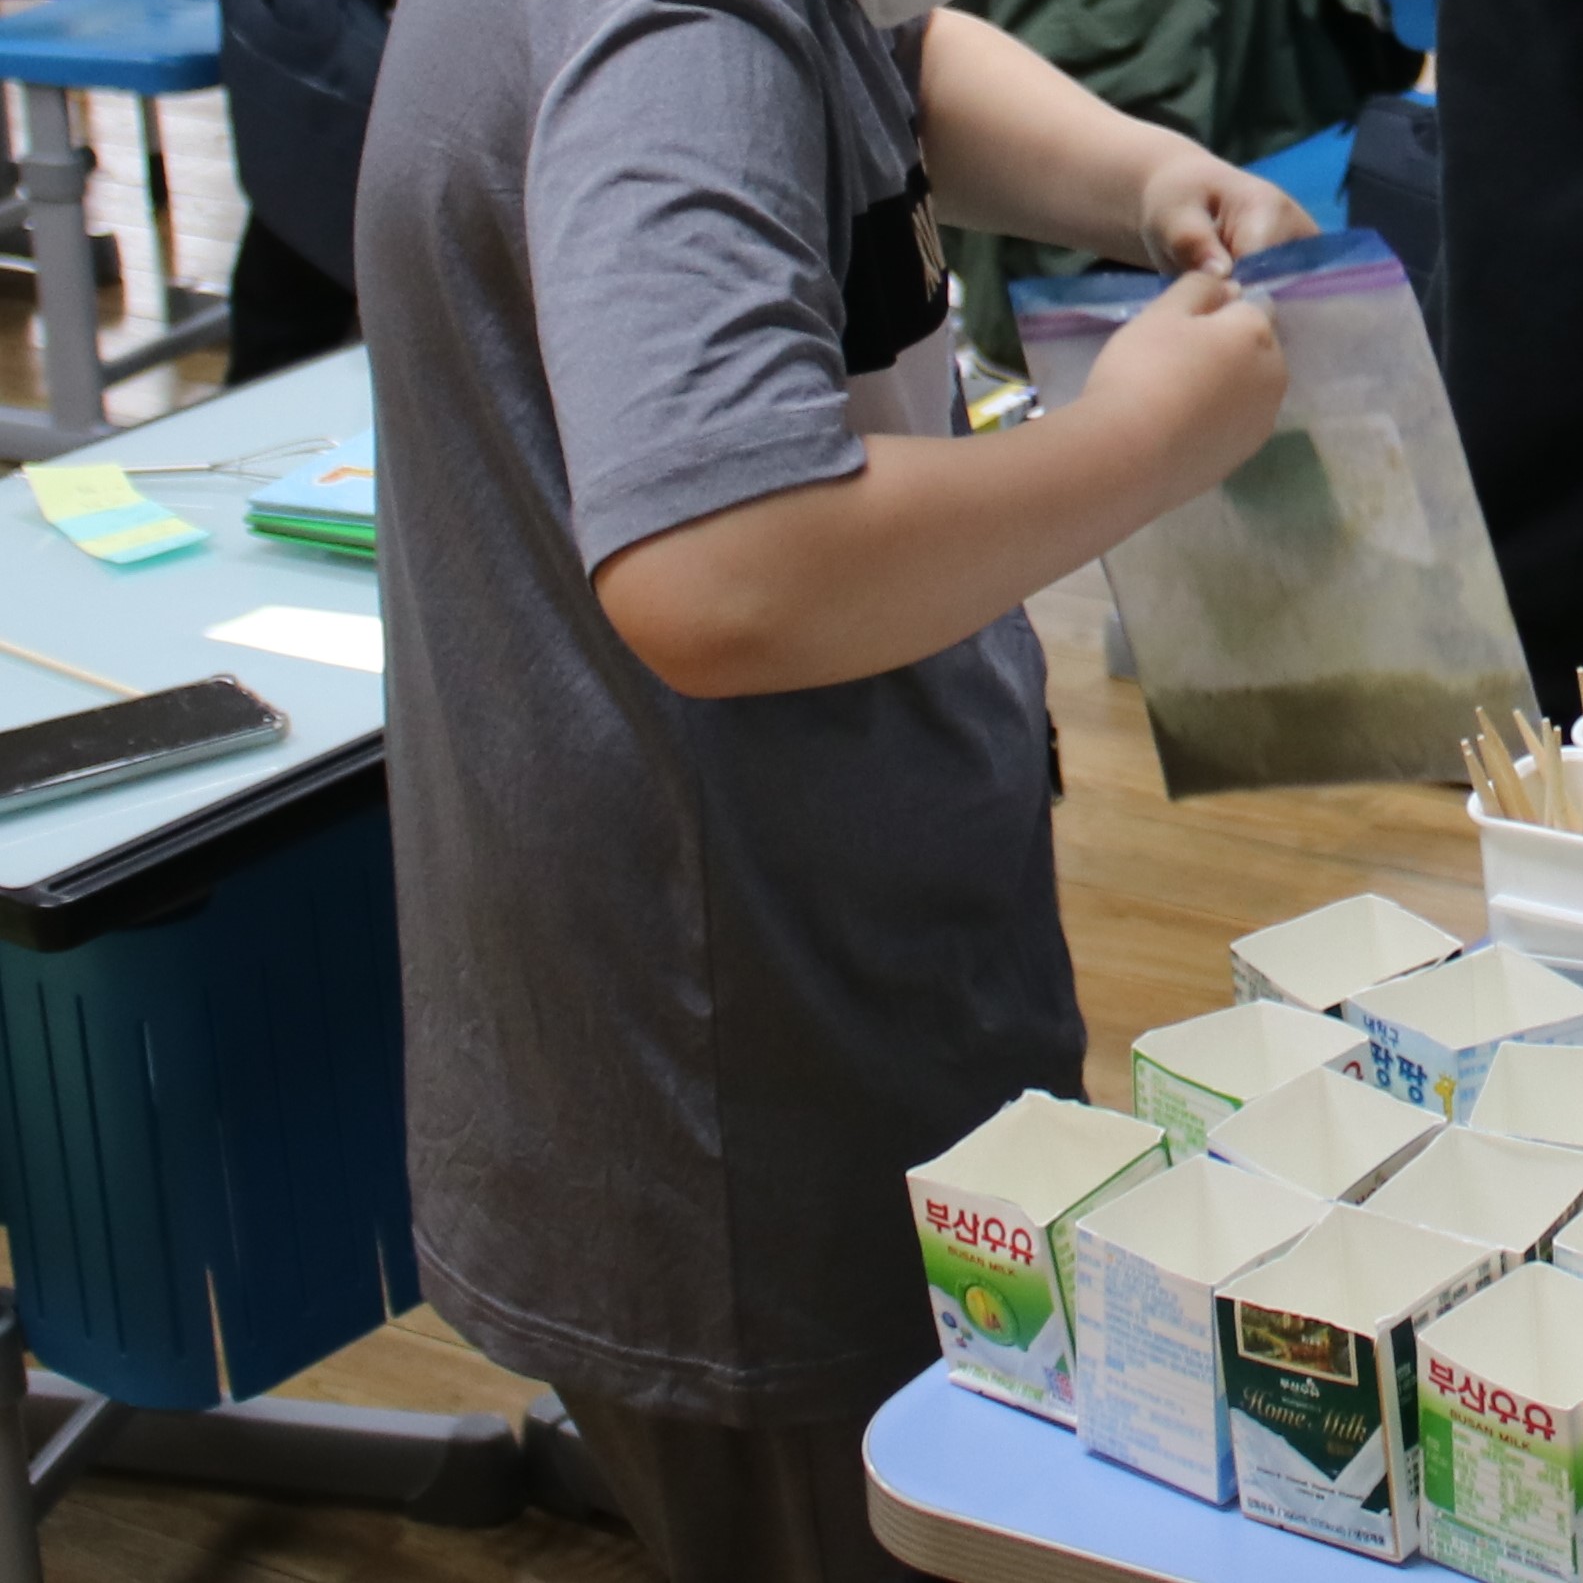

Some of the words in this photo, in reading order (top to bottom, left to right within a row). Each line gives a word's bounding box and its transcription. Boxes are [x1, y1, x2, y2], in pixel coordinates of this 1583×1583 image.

[926, 1199, 1034, 1266] 부산우유
[1428, 1358, 1556, 1441] 부산우유
[1450, 1409, 1493, 1438] BUSAN
[1498, 1432, 1531, 1451] MILK
